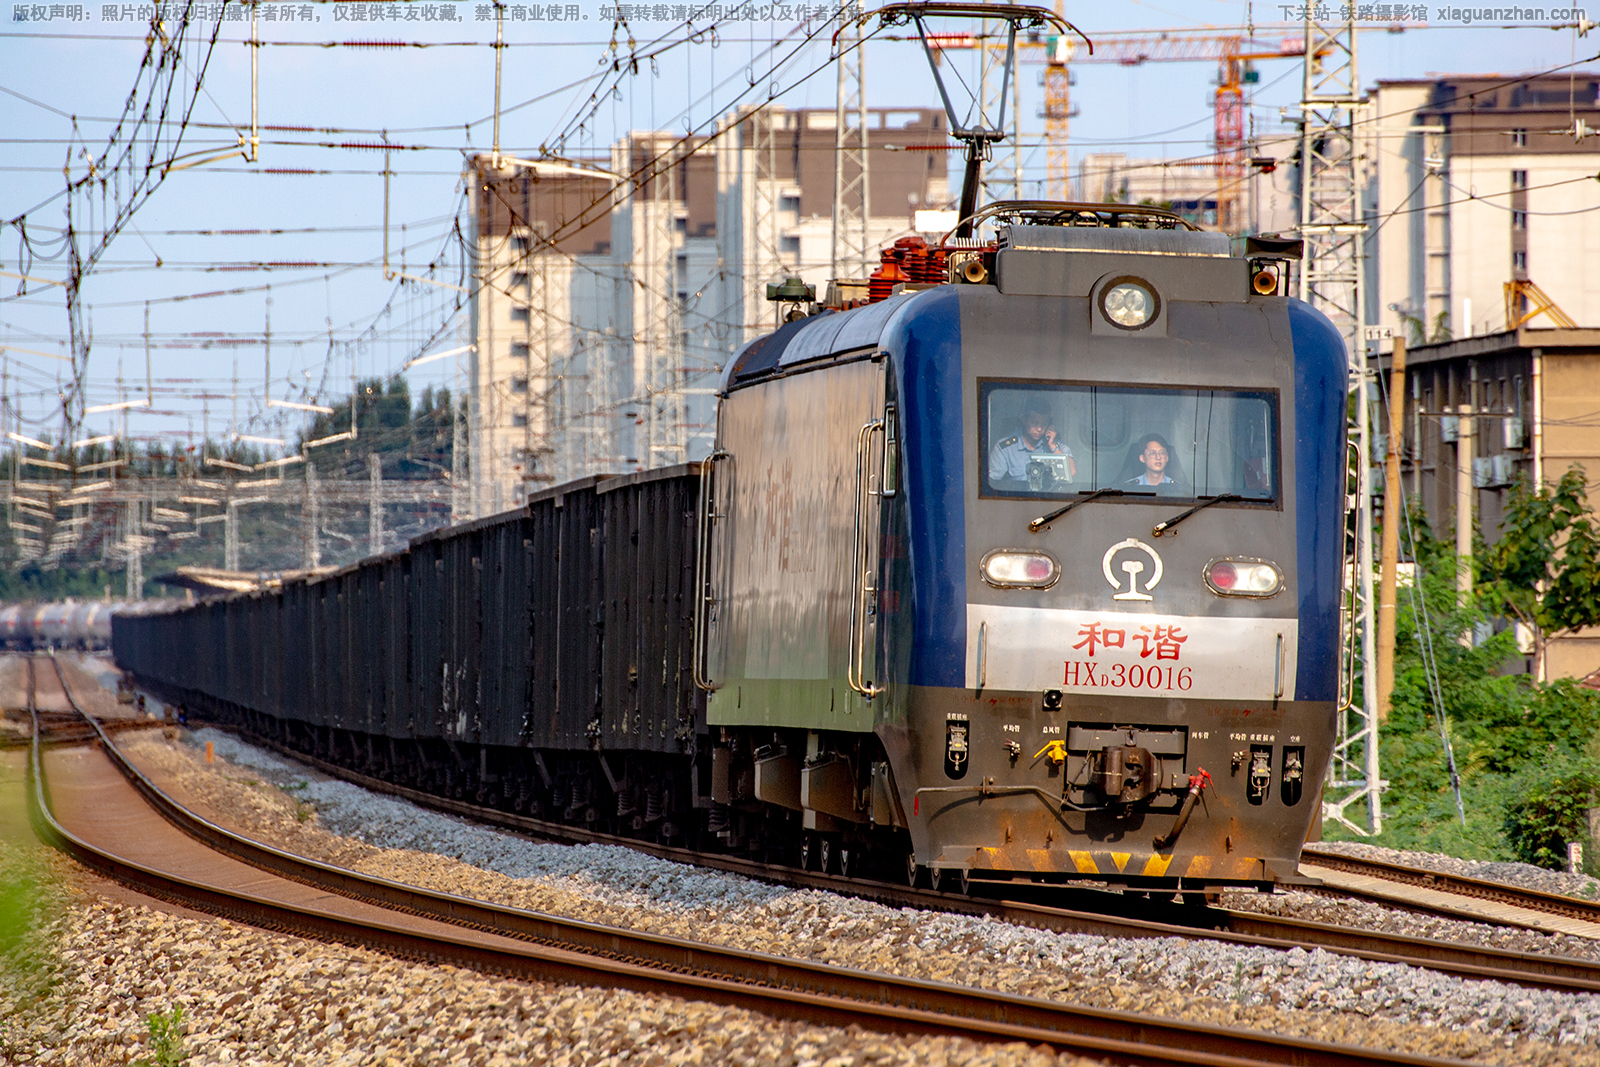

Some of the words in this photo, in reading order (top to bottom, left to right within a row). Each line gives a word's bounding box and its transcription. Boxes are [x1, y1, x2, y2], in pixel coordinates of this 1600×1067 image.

[1367, 329, 1391, 338] 114
[1072, 621, 1189, 661] 和谐
[1062, 660, 1193, 691] HXD30016
